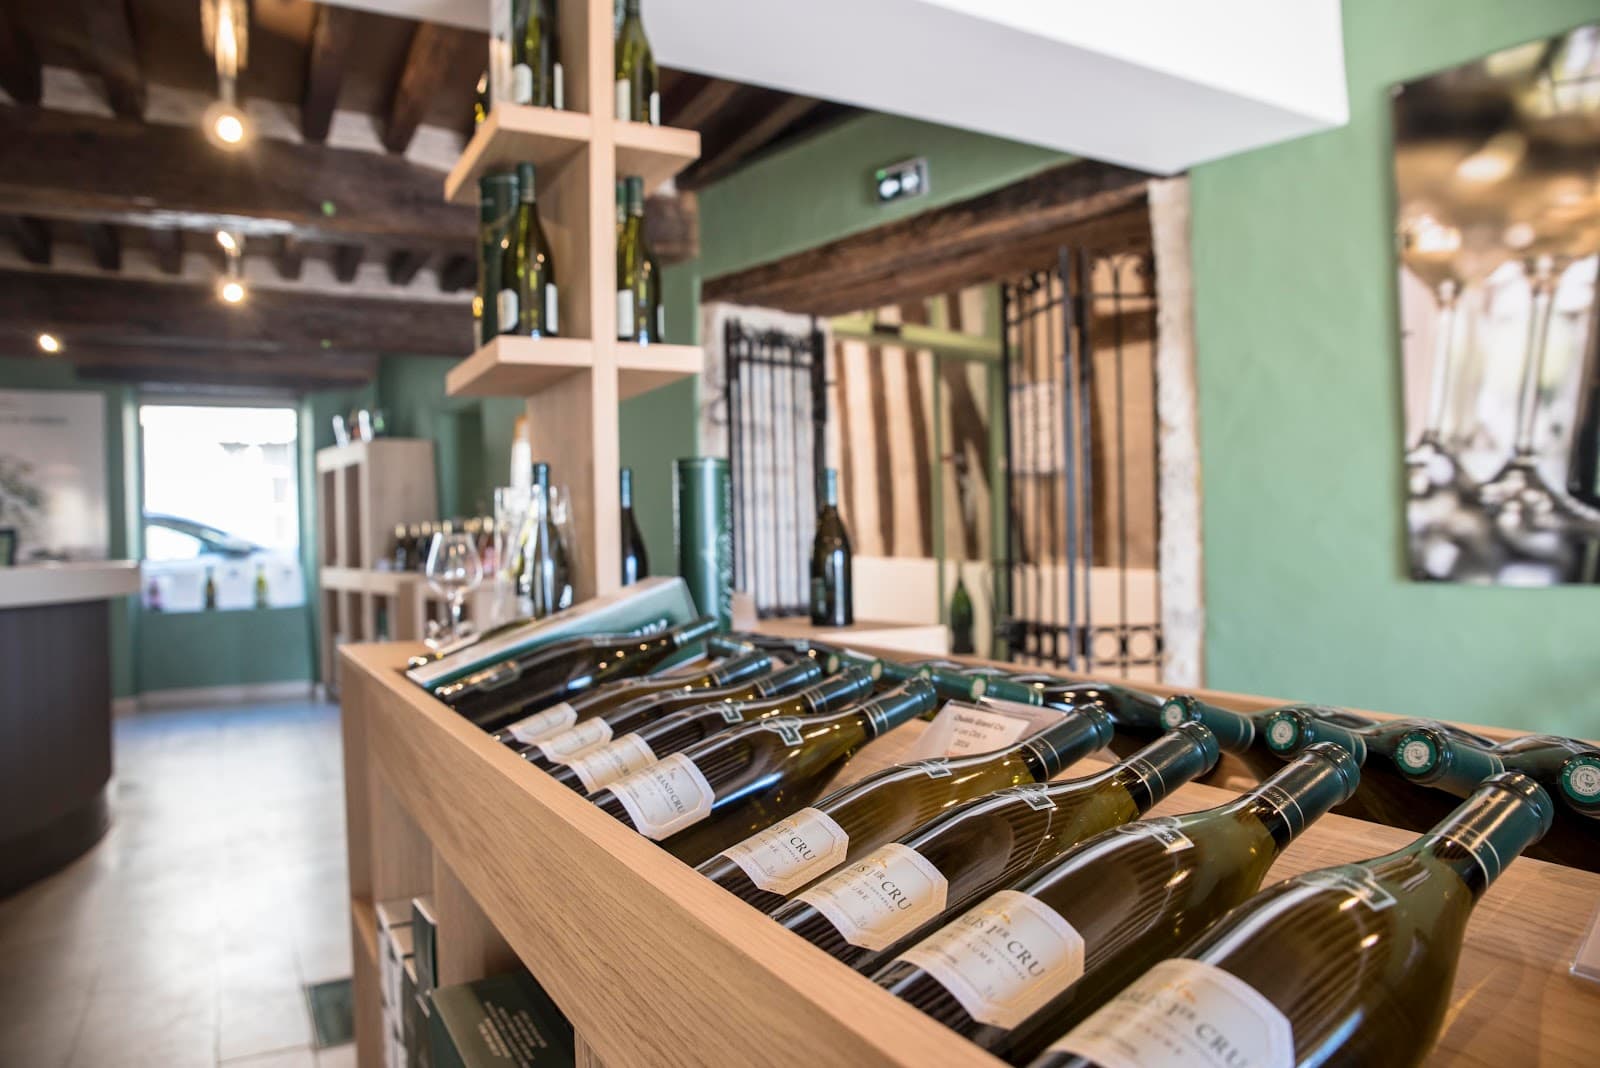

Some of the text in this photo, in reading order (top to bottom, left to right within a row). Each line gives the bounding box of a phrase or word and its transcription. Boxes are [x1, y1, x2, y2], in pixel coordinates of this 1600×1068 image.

[790, 836, 816, 861] CRU
[881, 881, 912, 910] CRU
[1007, 940, 1045, 977] CRU
